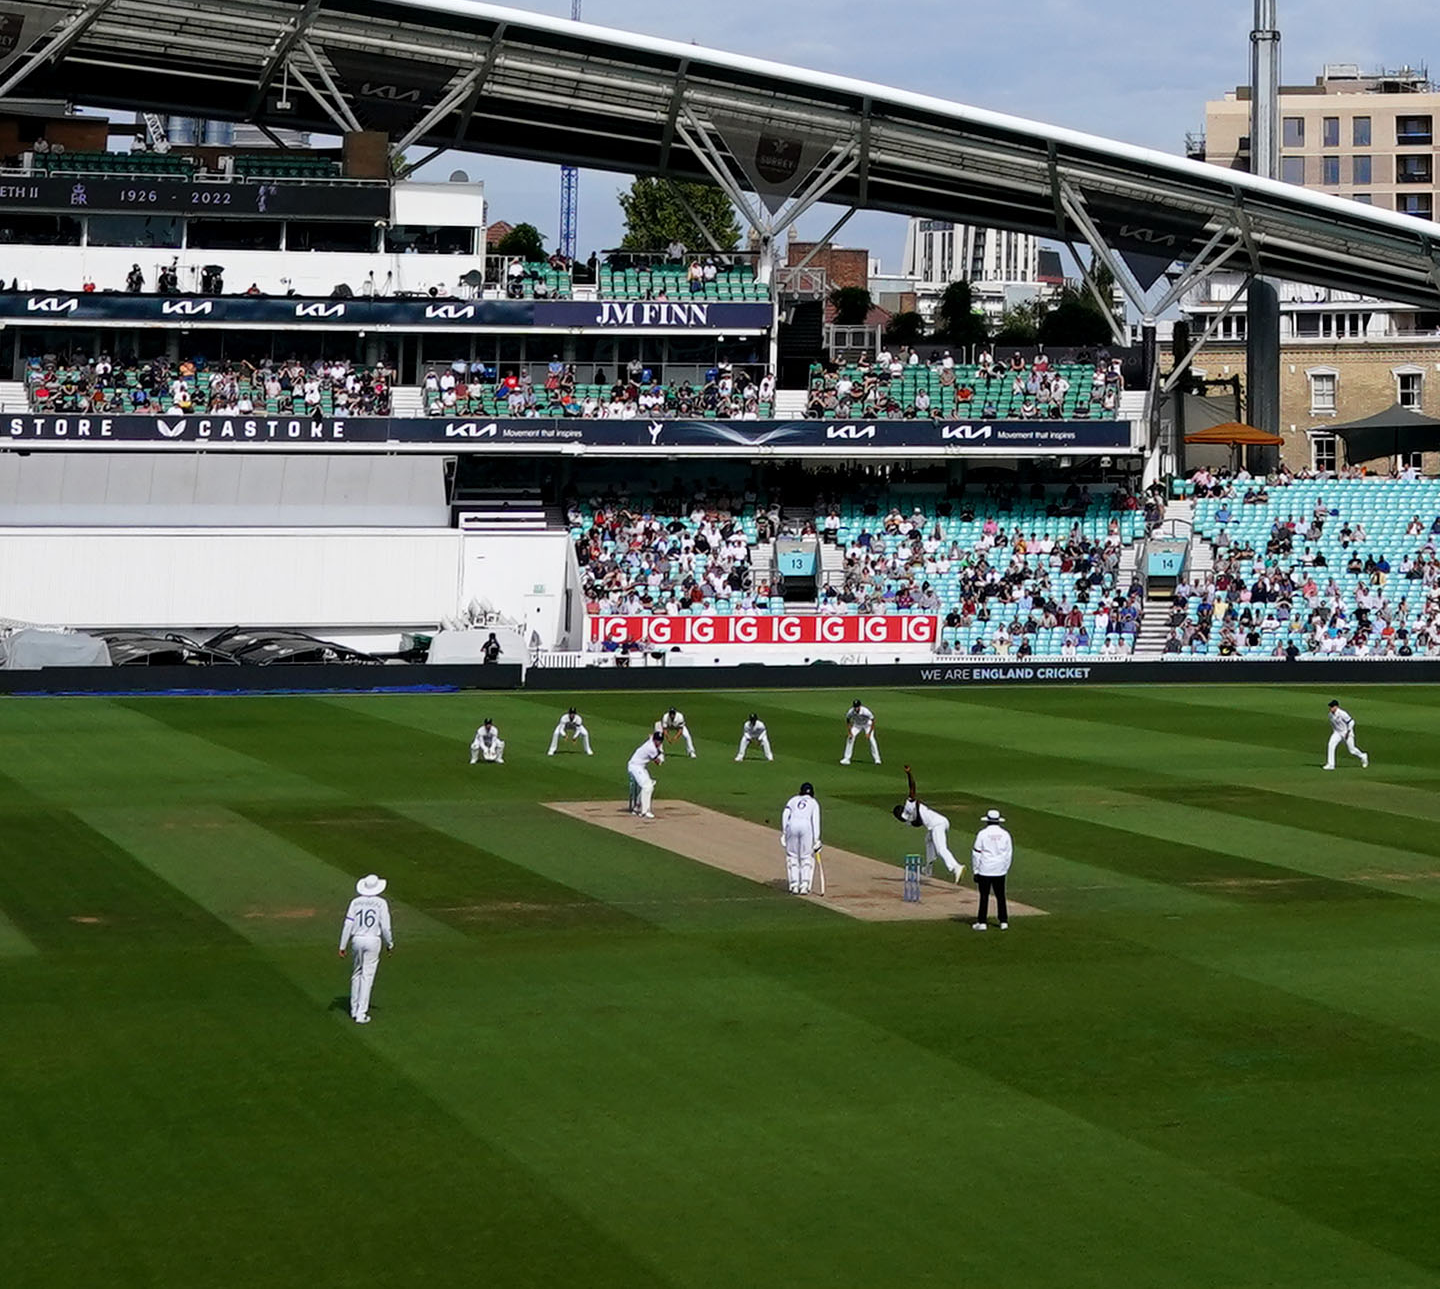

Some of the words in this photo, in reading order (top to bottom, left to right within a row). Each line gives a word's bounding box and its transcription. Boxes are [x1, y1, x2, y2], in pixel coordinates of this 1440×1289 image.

[29, 187, 39, 198] II
[120, 189, 158, 202] 1926
[191, 192, 233, 205] 2022
[596, 303, 635, 324] JM
[641, 304, 709, 325] FINN
[791, 558, 803, 569] 13
[1163, 559, 1173, 569] 14
[729, 618, 758, 641] IG
[816, 617, 844, 641] IG
[859, 617, 888, 640] IG
[902, 616, 930, 640] IG
[797, 799, 807, 810] 6
[356, 909, 376, 928] 16
